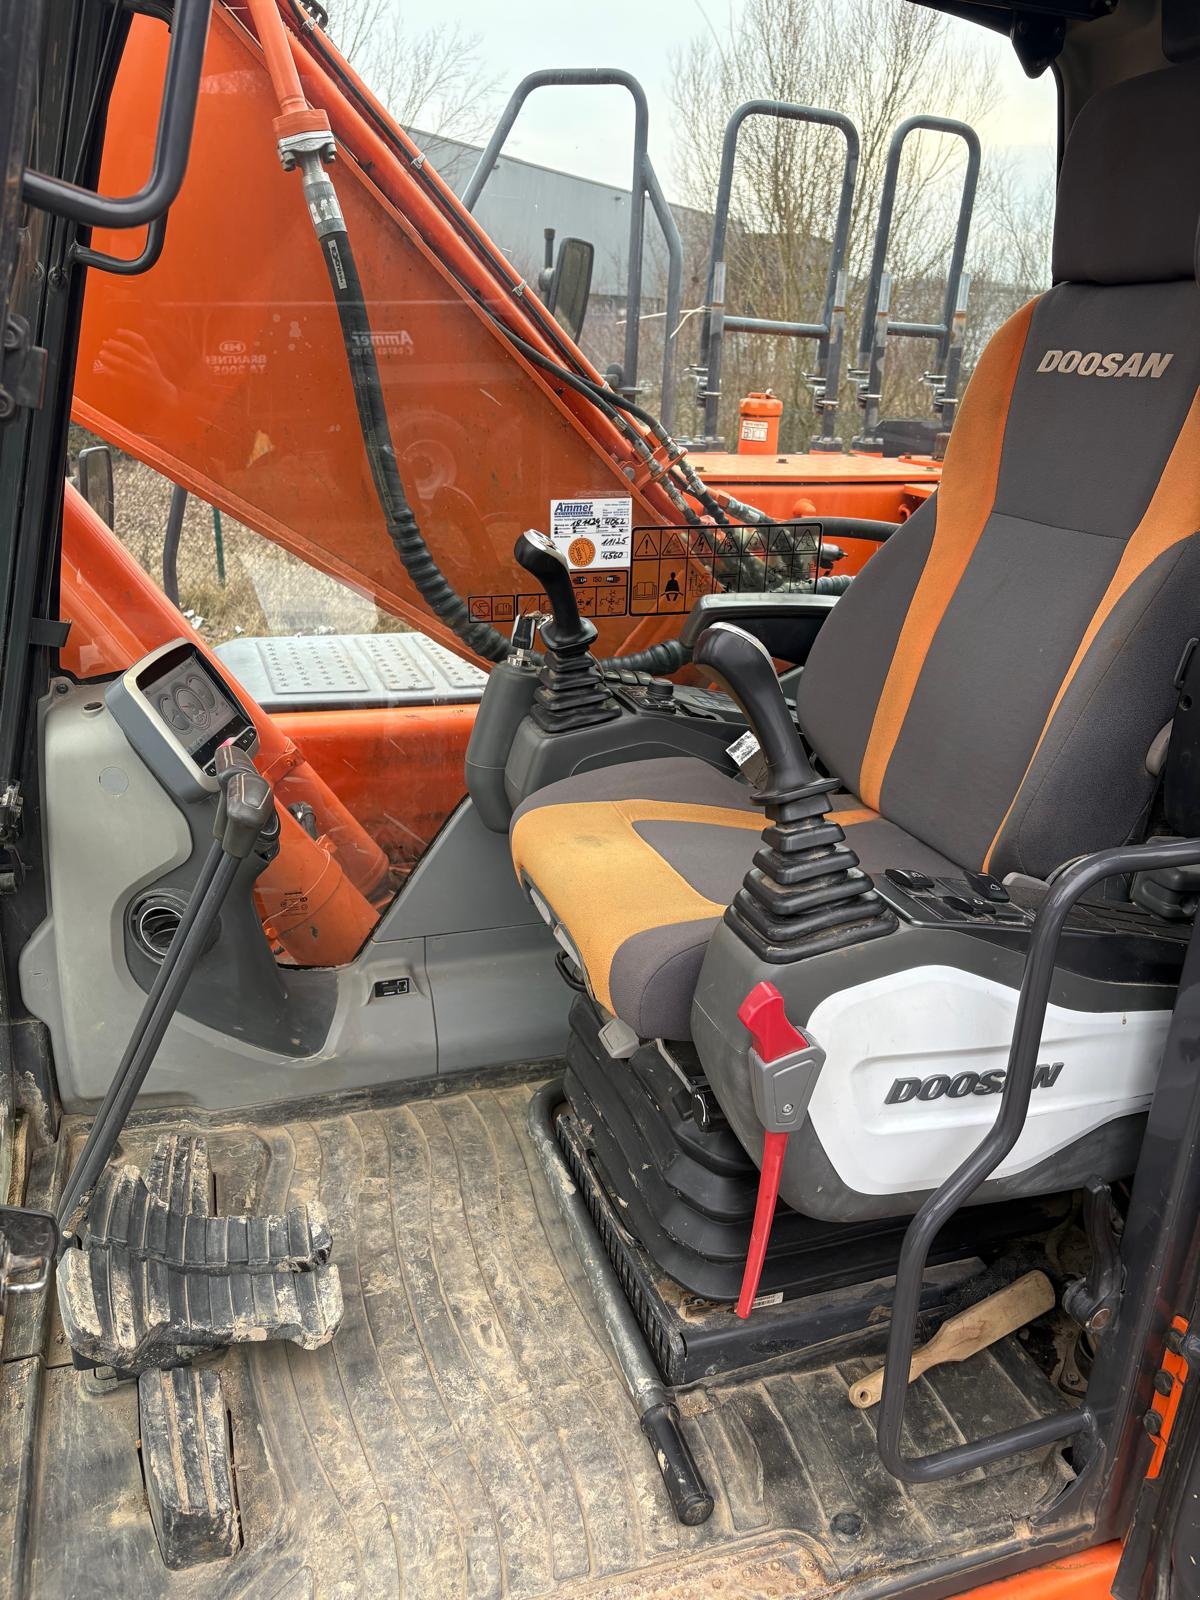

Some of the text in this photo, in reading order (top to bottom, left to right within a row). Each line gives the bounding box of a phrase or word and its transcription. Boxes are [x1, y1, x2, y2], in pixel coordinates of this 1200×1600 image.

[1036, 350, 1174, 378] DOOSAN
[555, 502, 593, 512] Ammer
[884, 1061, 1065, 1105] DOOSN
